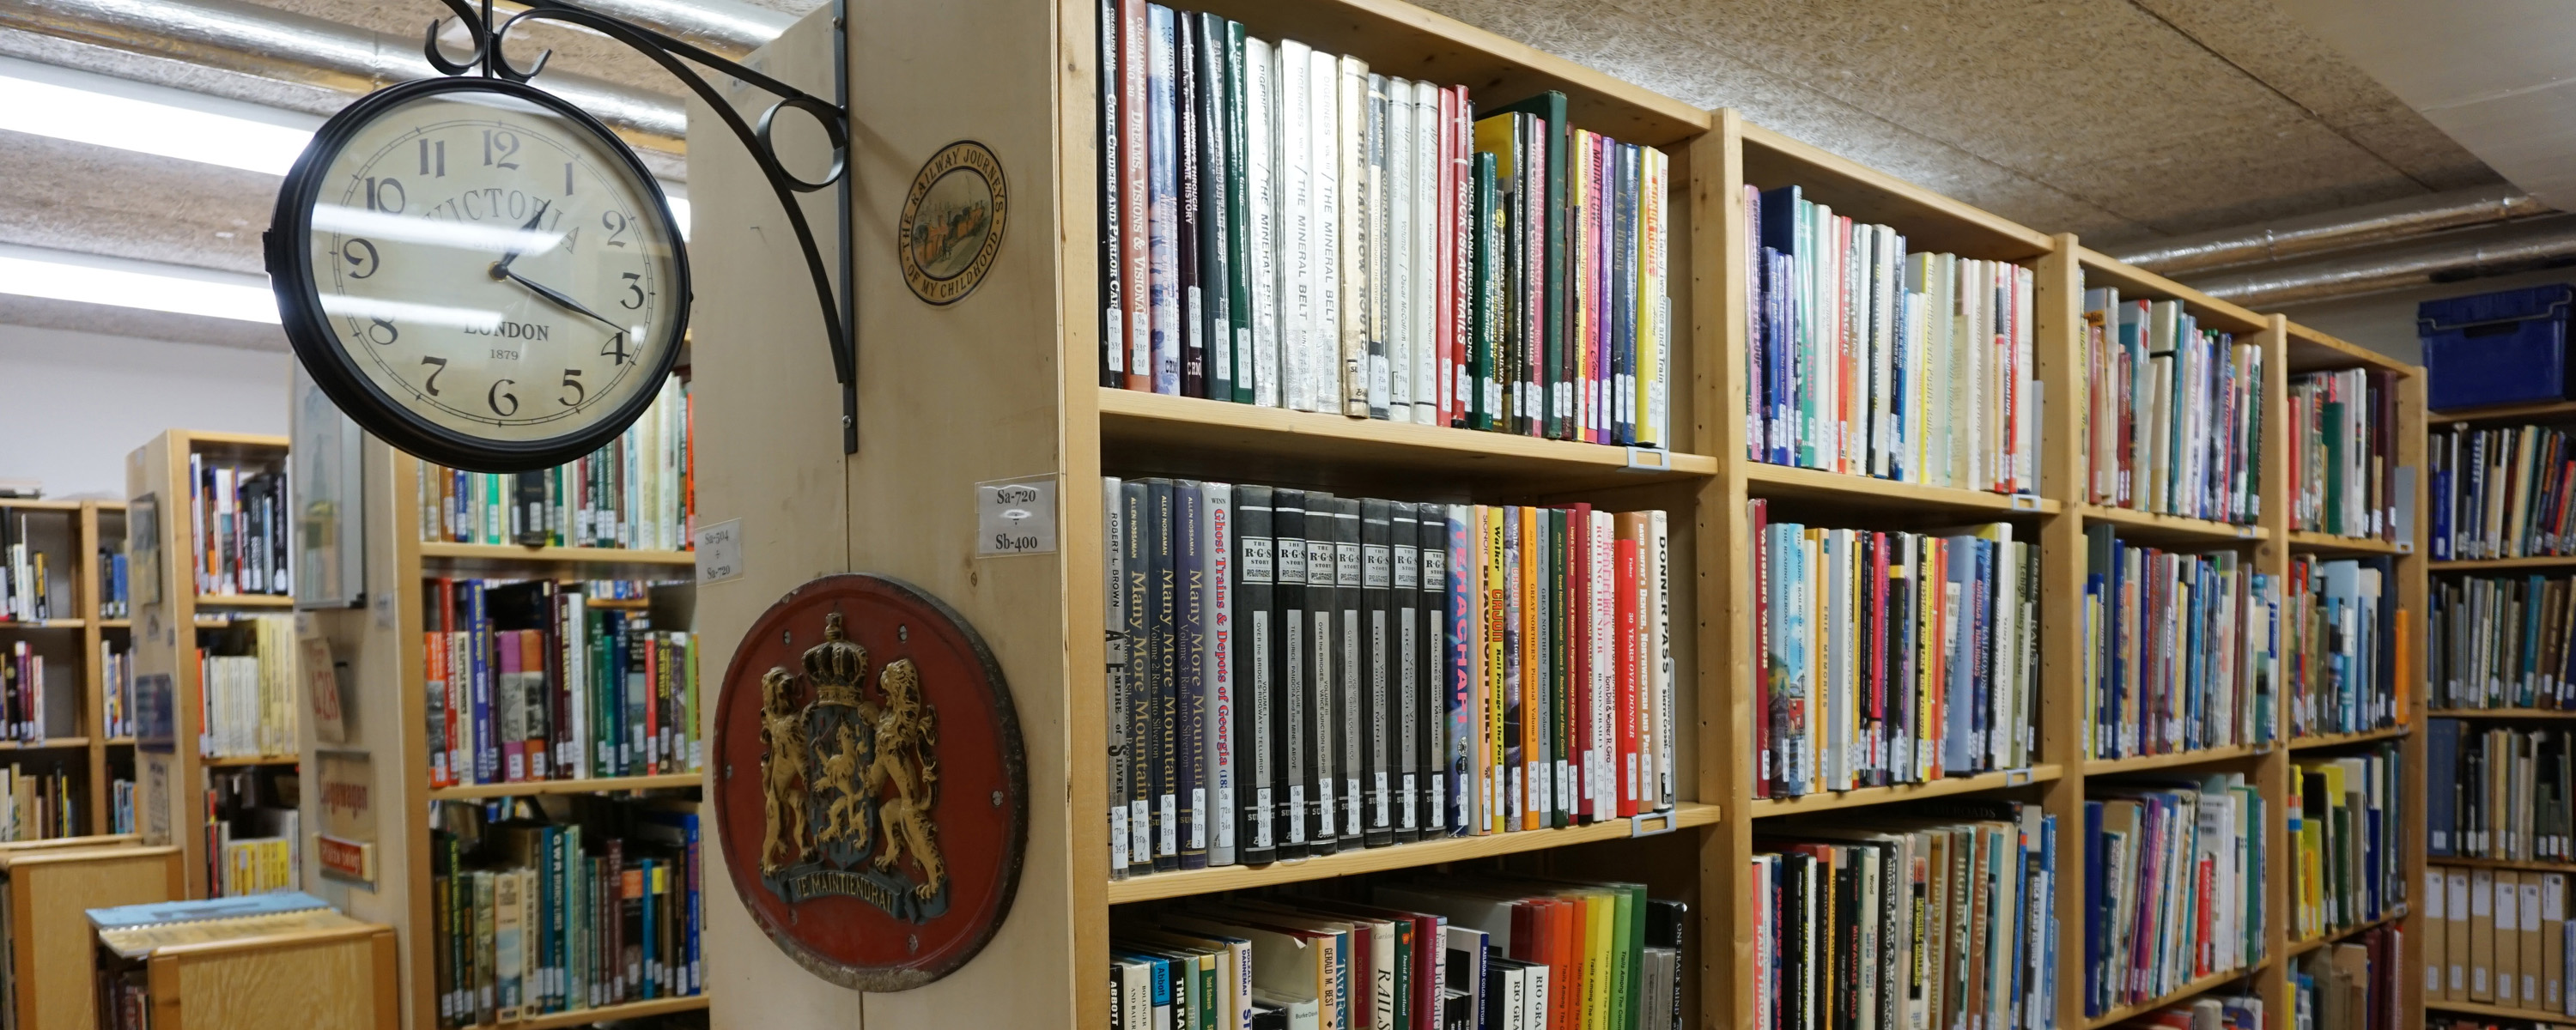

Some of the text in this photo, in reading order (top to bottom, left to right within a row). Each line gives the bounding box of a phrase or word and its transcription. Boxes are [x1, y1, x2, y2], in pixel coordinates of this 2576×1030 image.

[419, 137, 446, 179] 11
[483, 129, 520, 170] 12
[1357, 130, 1366, 156] THE
[365, 176, 405, 215] 10
[902, 147, 1004, 252] THE RAILWAY JOURNEYS
[1131, 179, 1146, 234] VISIONS
[1184, 183, 1193, 223] HISTORY
[422, 187, 580, 254] VICTORIA
[602, 209, 627, 247] 2
[1616, 213, 1626, 223] N
[343, 238, 380, 278] 9
[907, 231, 997, 298] OF MY CHILDHOOD
[1297, 179, 1308, 319] THE MINERAL BELT
[1324, 185, 1335, 324] THE MINERAL BELT
[1457, 180, 1467, 345] ROCK ISLAND RAILS
[1615, 229, 1626, 271] History
[1659, 260, 1666, 270] of
[620, 271, 644, 309] 3
[368, 314, 398, 344] 8
[464, 321, 550, 341] LONDON
[600, 330, 631, 366] 4
[421, 354, 447, 396] 7
[490, 348, 519, 360] 1879
[488, 379, 519, 415] 6
[558, 368, 584, 406] 5
[997, 489, 1036, 506] Sa-720
[996, 533, 1037, 552] Sb-400
[1213, 508, 1228, 554] Ghost
[708, 565, 730, 579] Sa-720
[1213, 557, 1229, 609] Trains
[1130, 571, 1147, 627] Many
[1160, 568, 1176, 626] Many
[1492, 588, 1504, 643] CAJON
[1659, 536, 1670, 675] DONNER PASS
[1760, 528, 1769, 670] VANISHING VARNISH
[1188, 569, 1205, 687] Many More
[1214, 613, 1229, 627] &
[1455, 527, 1467, 724] TEHACHAPI
[1132, 635, 1148, 691] More
[1161, 631, 1177, 688] More
[1214, 630, 1229, 682] Depots
[1151, 624, 1161, 759] Volume 2: Ruts into Silverton
[1181, 625, 1190, 768] Volume 3: Rails into Silverton
[1215, 686, 1230, 703] of
[1215, 705, 1230, 766] Georgia
[1496, 713, 1503, 723] to
[796, 872, 892, 913] JE MAINTIENDRAI
[1176, 977, 1185, 1005] THE
[1325, 948, 1334, 1007] GERALD M. BEST
[1110, 980, 1120, 1027] ABBOTT
